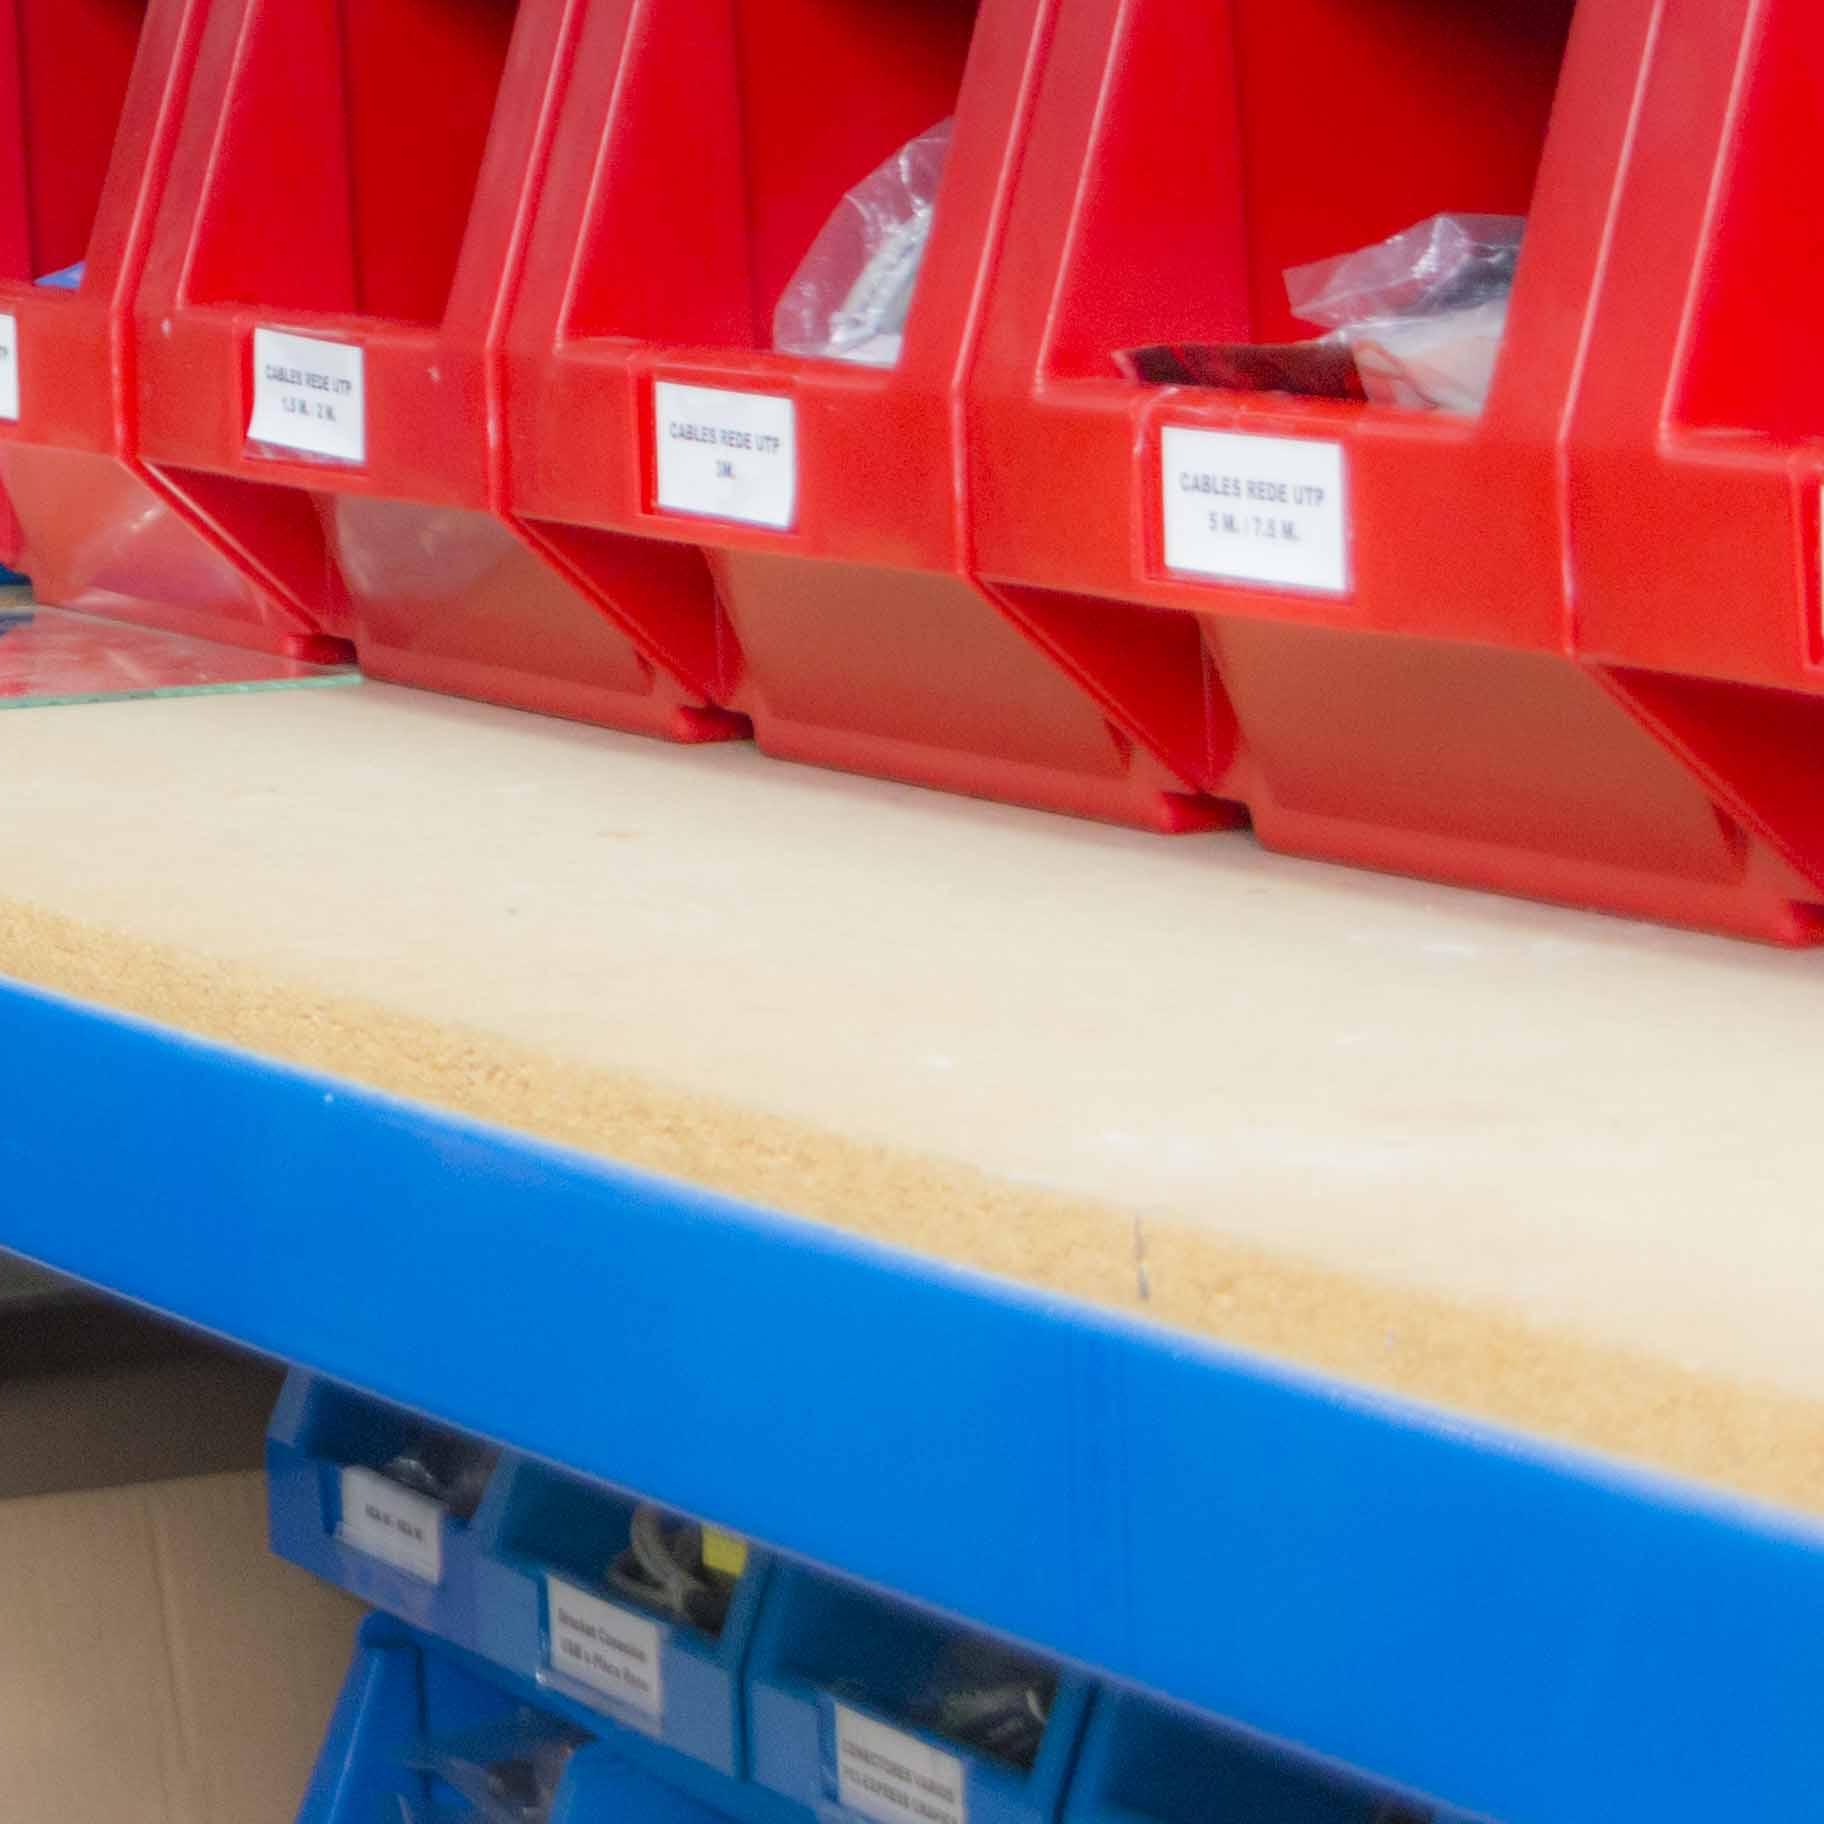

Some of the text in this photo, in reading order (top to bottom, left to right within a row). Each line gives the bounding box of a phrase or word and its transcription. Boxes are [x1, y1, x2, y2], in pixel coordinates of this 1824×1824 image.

[265, 362, 302, 386] CABLES
[305, 371, 329, 392] REDE
[671, 421, 780, 455] CABLES REDE UTP
[1179, 471, 1325, 506] CABLES REDE UTP
